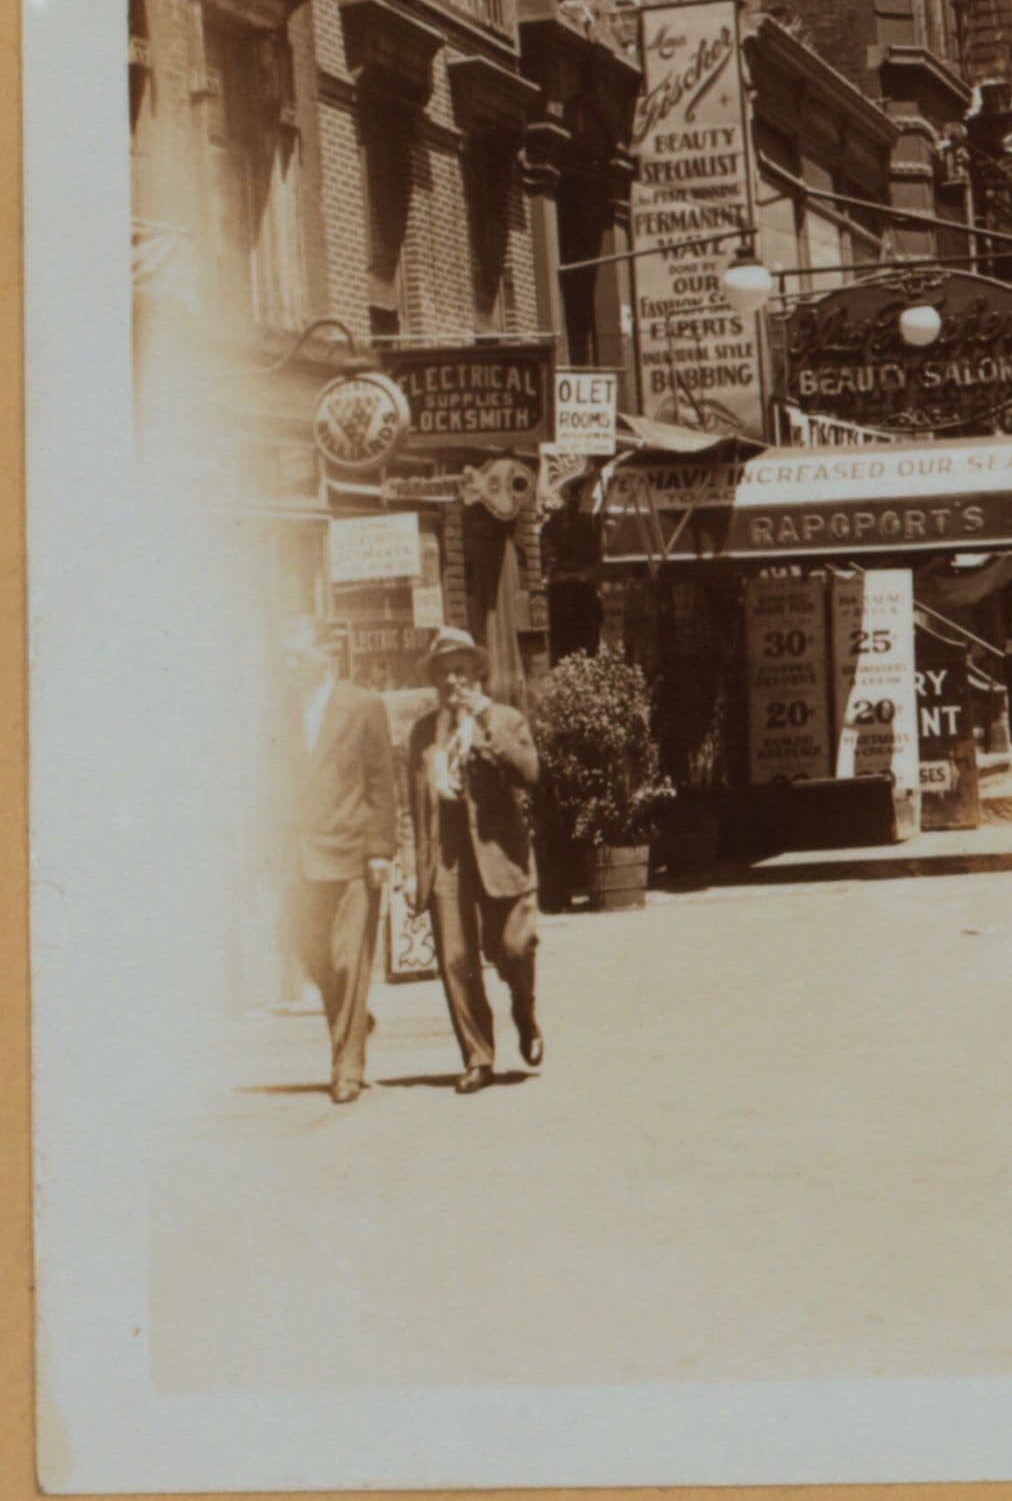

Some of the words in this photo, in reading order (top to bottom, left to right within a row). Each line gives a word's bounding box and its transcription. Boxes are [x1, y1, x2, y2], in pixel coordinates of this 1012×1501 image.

[654, 128, 736, 154] BEAUTY
[643, 153, 740, 185] SPECIALIST
[634, 204, 746, 237] PERMANENT
[673, 275, 721, 294] OUR
[650, 315, 745, 341] EXPERTS
[714, 341, 754, 359] STYLE
[651, 363, 753, 394] BOBBING
[798, 362, 908, 398] BEAUTY
[559, 411, 610, 429] ROOMS
[725, 461, 886, 487] INCREASED
[897, 456, 953, 478] OUR
[749, 502, 986, 545] RAPOPORT'S
